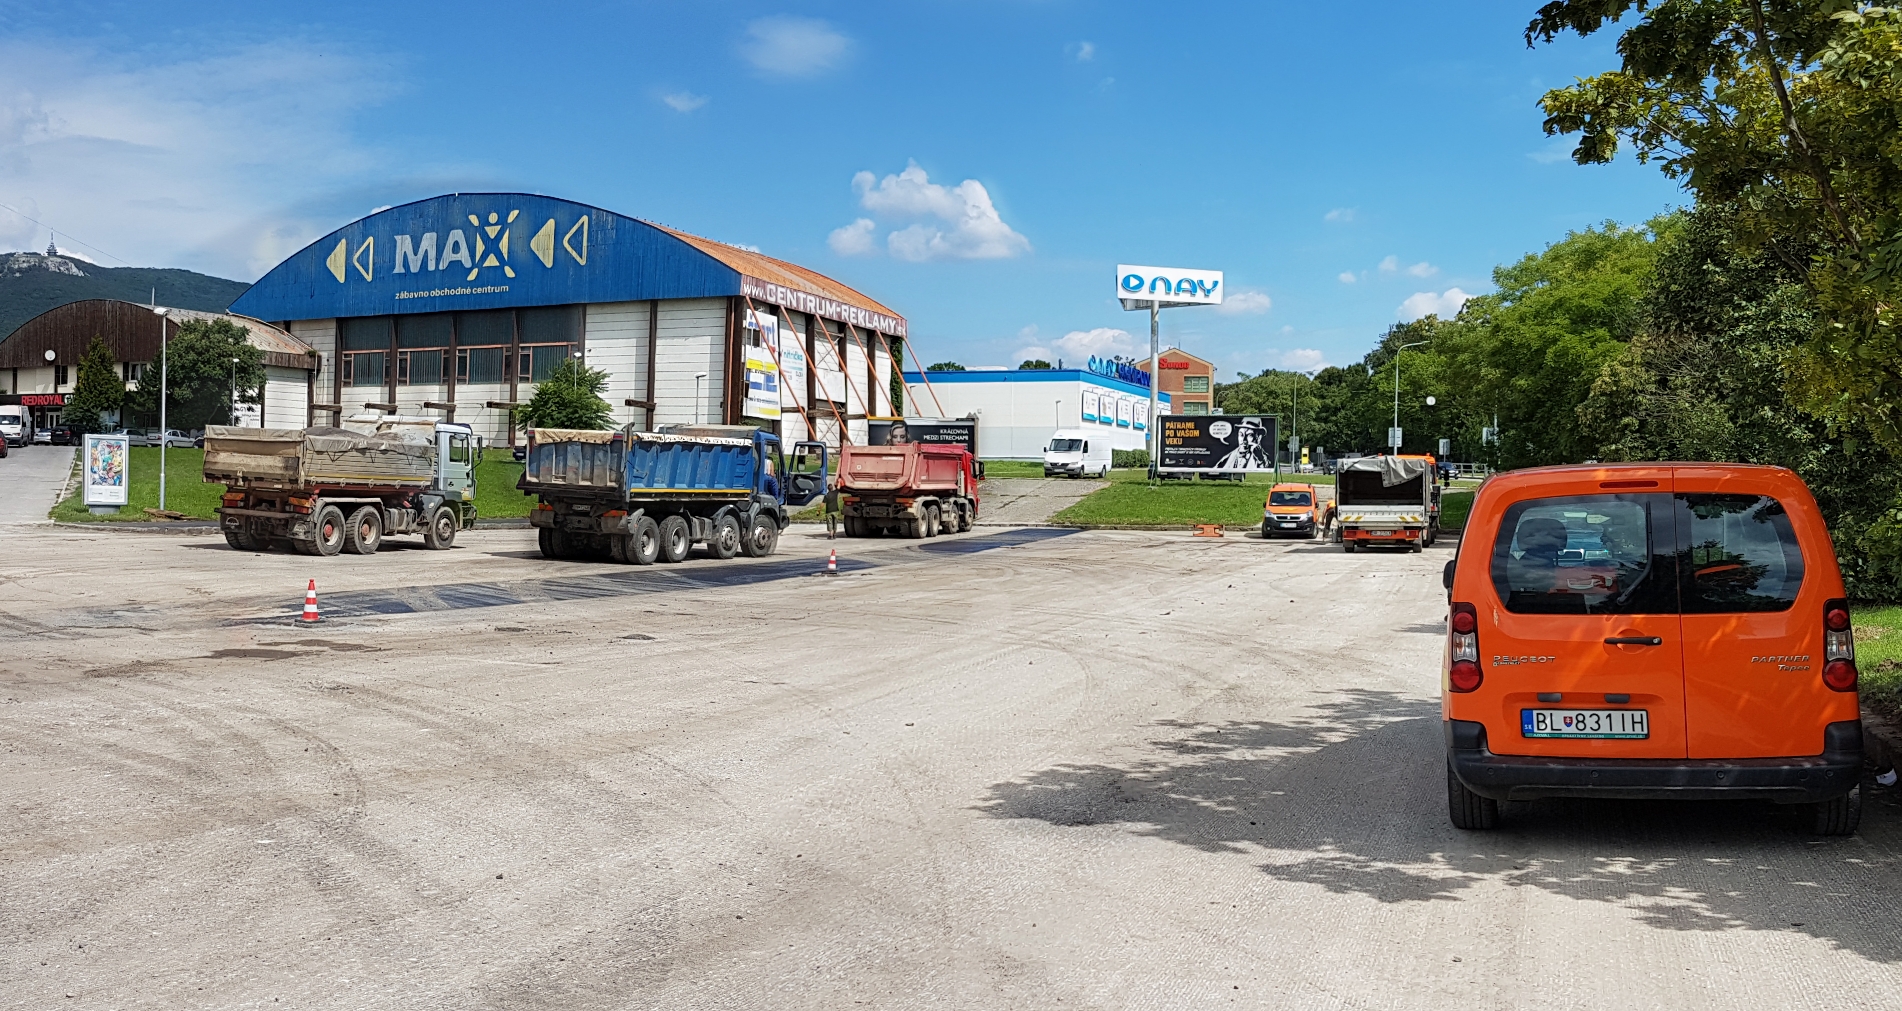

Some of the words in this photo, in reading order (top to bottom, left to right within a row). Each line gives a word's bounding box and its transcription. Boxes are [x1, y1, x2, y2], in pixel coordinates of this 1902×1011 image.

[395, 290, 429, 299] zábavno
[430, 286, 471, 296] obchodné
[472, 285, 509, 295] centrum
[1165, 421, 1195, 429] PÁTRAME
[1177, 429, 1200, 437] VAŠOM
[1493, 655, 1556, 663] PEUGEOT
[1751, 655, 1810, 663] PARTNER
[1777, 664, 1811, 672] Tepee
[1536, 712, 1563, 732] BL
